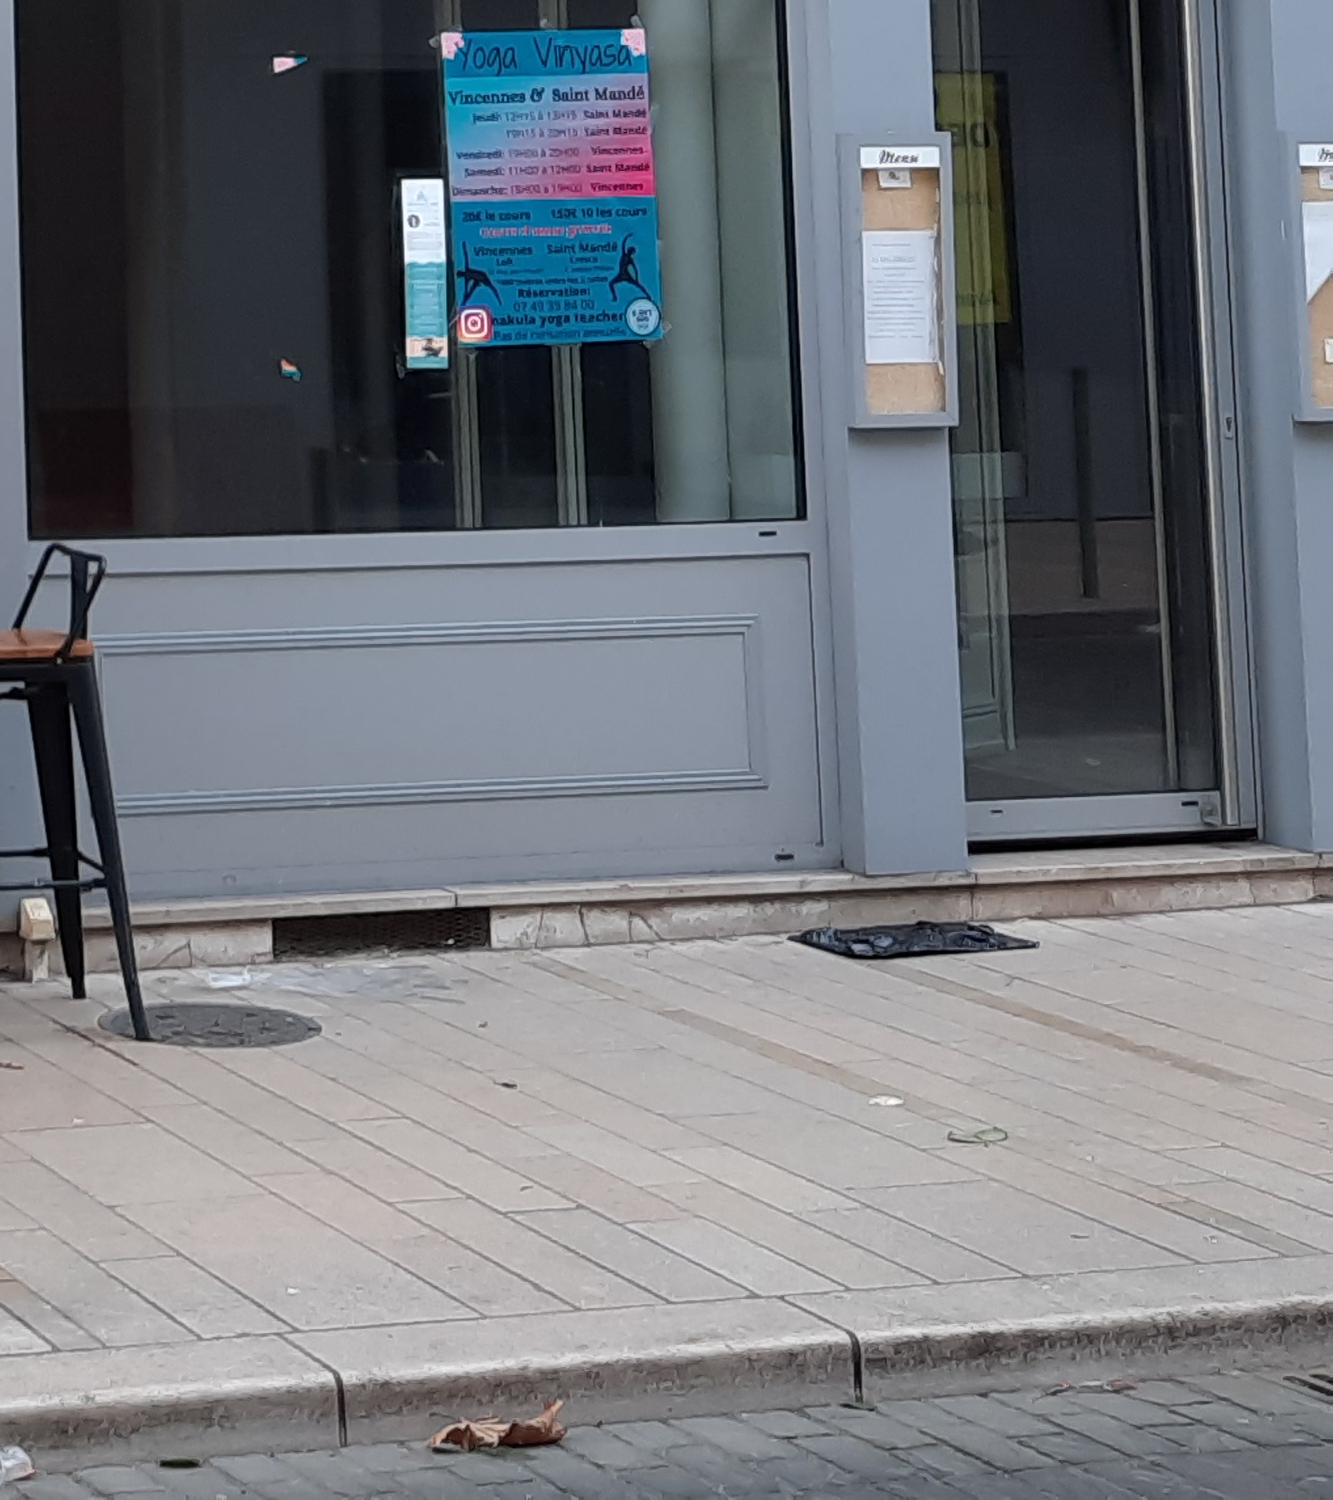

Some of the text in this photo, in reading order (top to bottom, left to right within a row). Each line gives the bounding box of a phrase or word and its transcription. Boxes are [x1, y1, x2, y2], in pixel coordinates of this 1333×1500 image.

[459, 36, 633, 77] Yoga Vinyasa
[448, 90, 526, 106] Vincennes
[552, 86, 589, 102] Saint
[595, 84, 645, 100] Mandé
[539, 315, 571, 328] yoga
